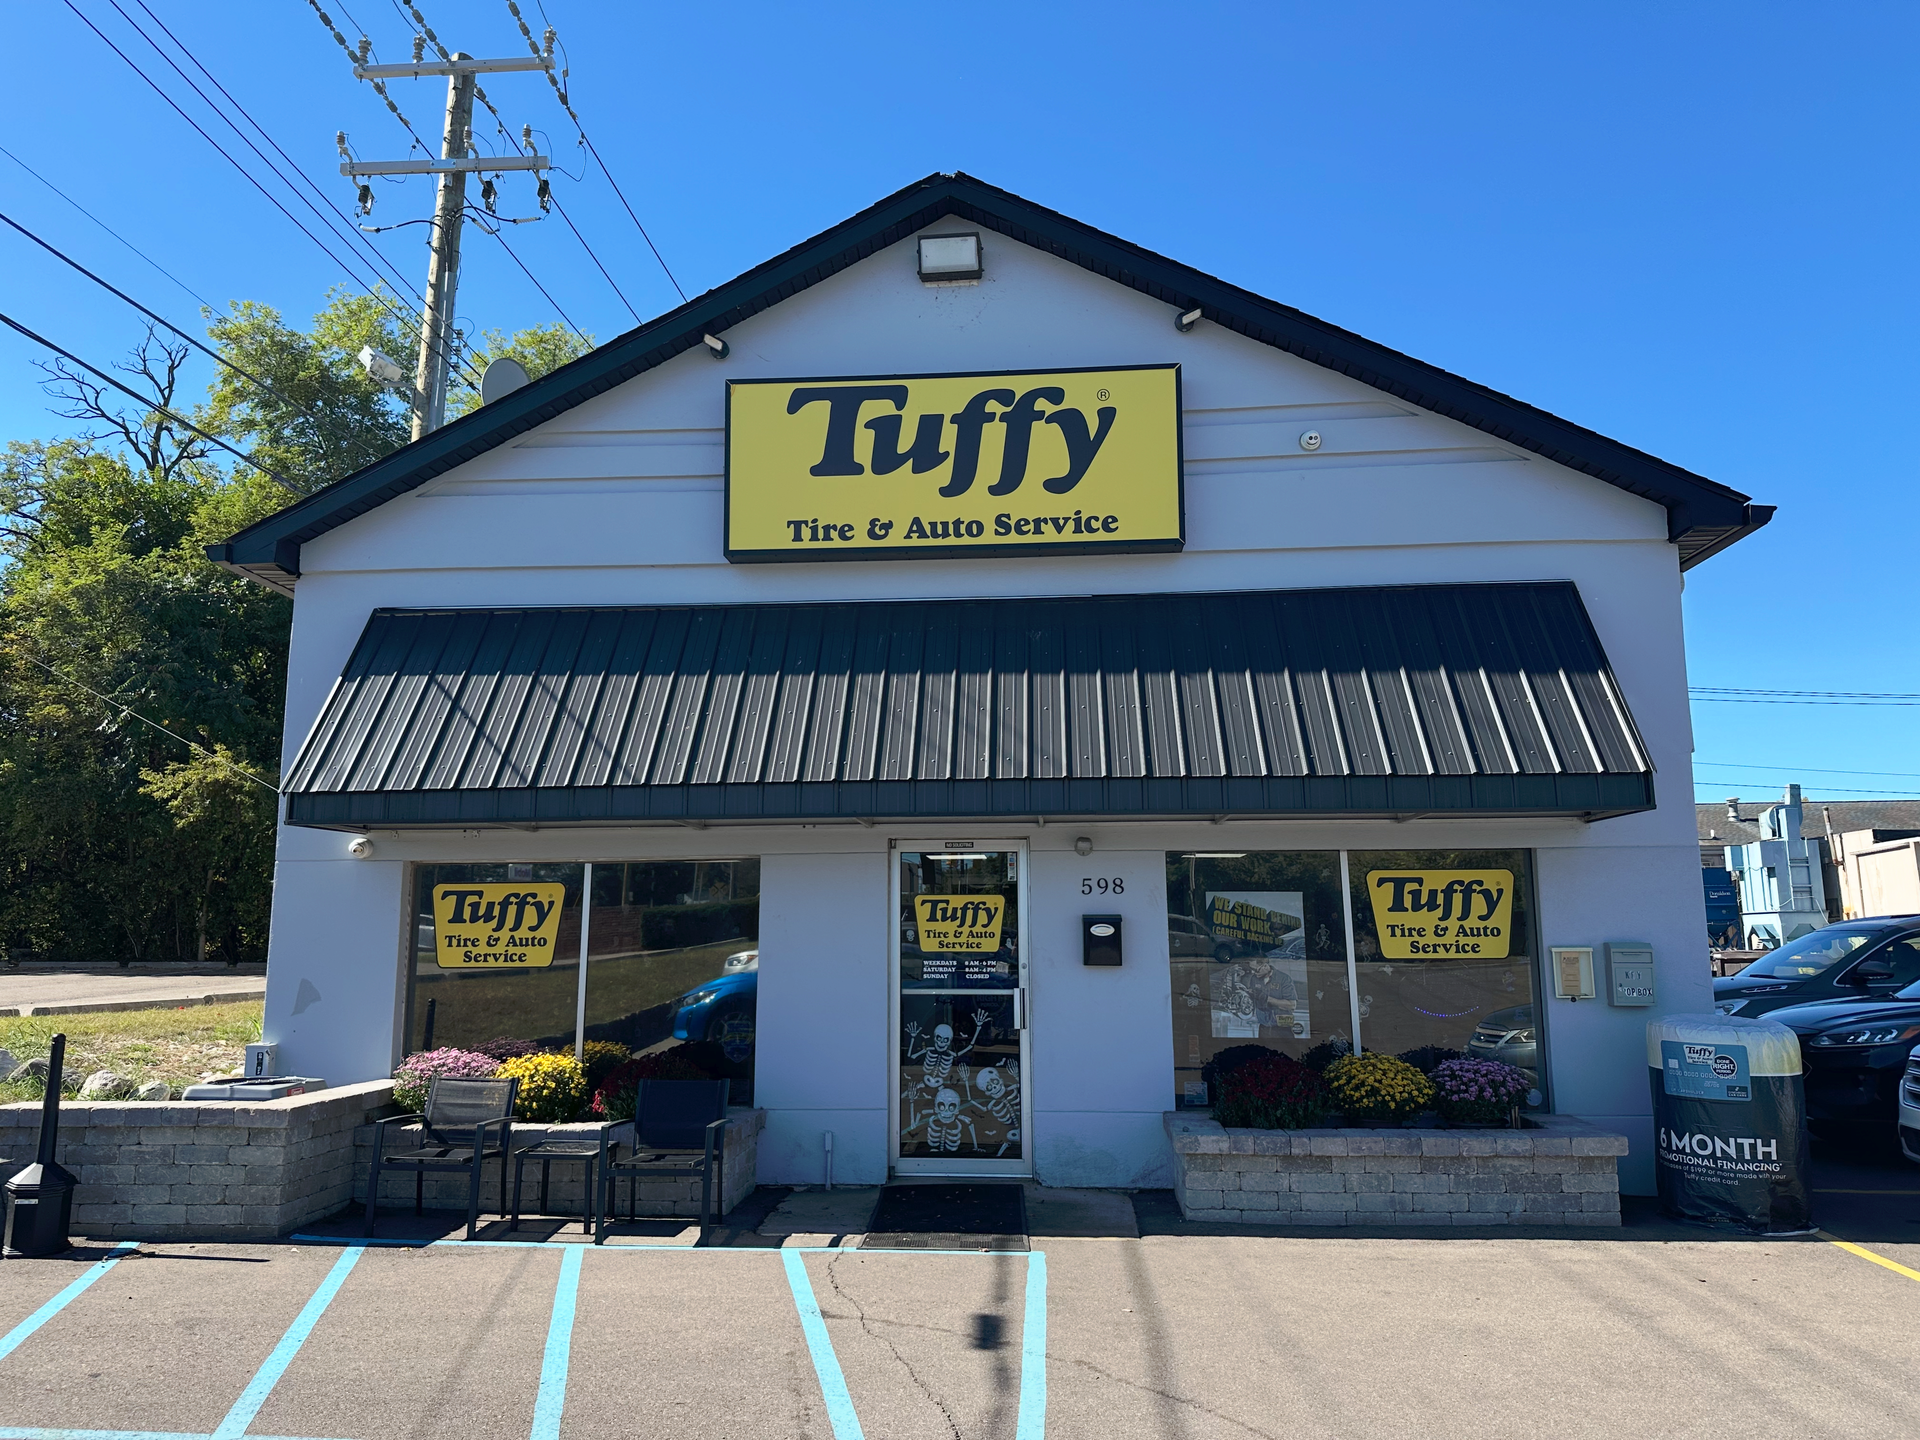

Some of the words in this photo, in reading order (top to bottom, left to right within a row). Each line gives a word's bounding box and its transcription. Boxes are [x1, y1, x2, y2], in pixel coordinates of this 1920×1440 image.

[786, 384, 1117, 498] Tuffy
[787, 518, 855, 543] Tire
[866, 517, 893, 541] &
[903, 515, 985, 541] Auto
[993, 509, 1119, 538] Service
[1081, 877, 1125, 895] 598
[1376, 876, 1504, 922] Tuffy
[441, 890, 555, 932] Tuffy
[920, 899, 999, 928] Tuffy
[1214, 895, 1230, 912] WE
[1234, 901, 1268, 920] STAND
[1213, 910, 1238, 928] OUR
[924, 930, 950, 938] Tire
[954, 930, 963, 938] &
[966, 930, 996, 938] Auto
[1386, 924, 1427, 938] Tire
[1433, 924, 1449, 938] &
[1455, 924, 1502, 938] Auto
[444, 934, 480, 948] Tire
[486, 935, 500, 948] &
[505, 934, 548, 948] Auto
[938, 940, 982, 949] Service
[1409, 940, 1481, 954] Service
[462, 950, 528, 963] Service
[1637, 987, 1653, 996] BOX
[1686, 1046, 1714, 1057] Tuffy
[1660, 1127, 1668, 1148] 6
[1670, 1129, 1778, 1160] MONTH
[1684, 1172, 1699, 1180] Tuffy
